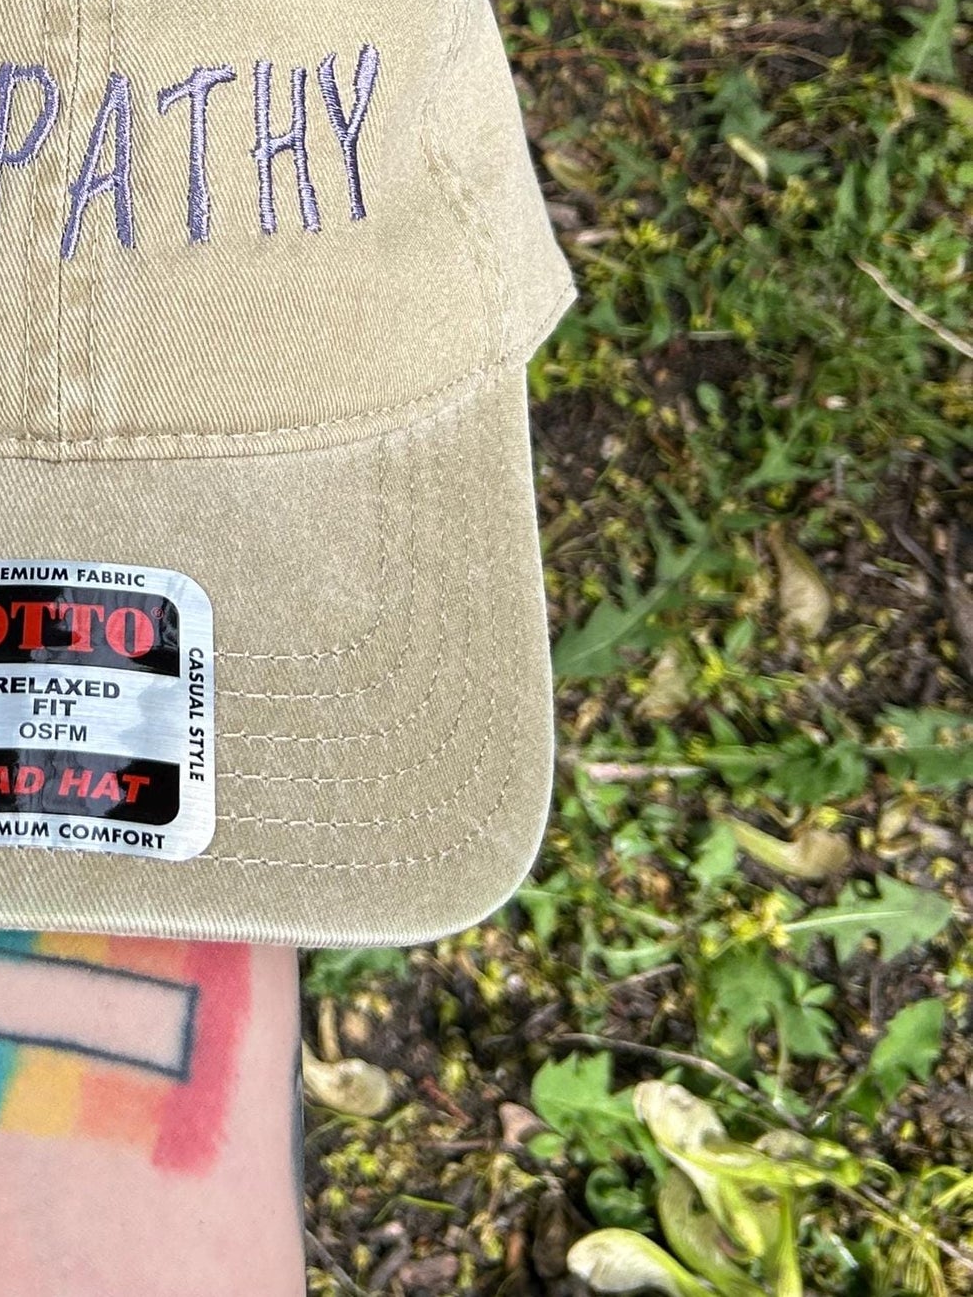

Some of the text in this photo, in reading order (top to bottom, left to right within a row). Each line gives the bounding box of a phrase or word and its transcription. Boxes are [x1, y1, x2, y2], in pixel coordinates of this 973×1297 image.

[77, 569, 145, 587] FABRIC
[32, 698, 77, 717] FIT
[189, 647, 205, 781] CASUAL STYLE
[19, 722, 87, 742] OSFM
[58, 768, 150, 804] HAT
[58, 823, 165, 849] COMFORT
